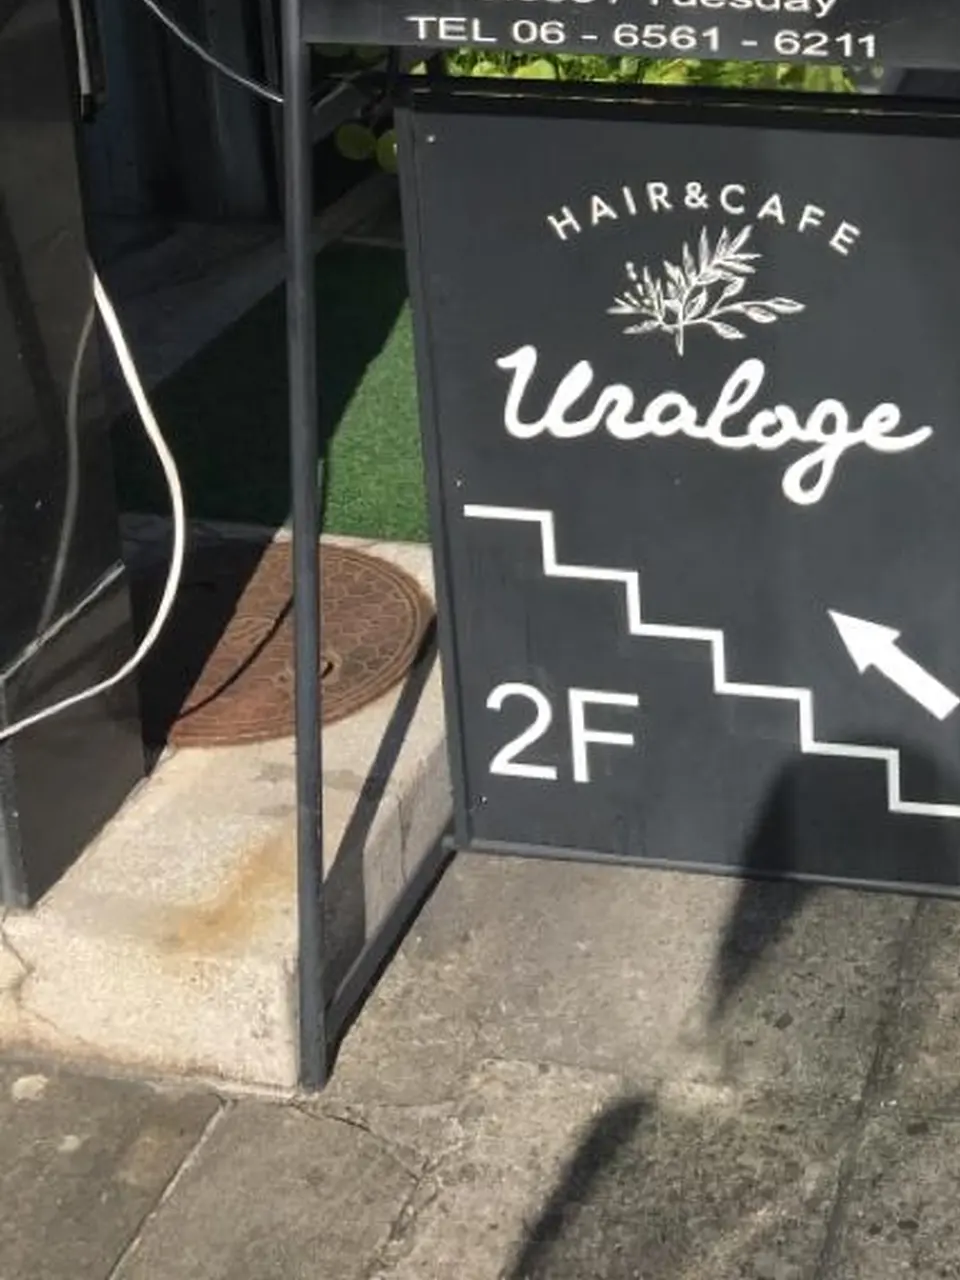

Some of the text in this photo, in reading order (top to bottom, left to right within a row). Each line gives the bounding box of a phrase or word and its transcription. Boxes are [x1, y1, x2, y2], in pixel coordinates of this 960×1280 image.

[406, 15, 498, 43] TEL
[511, 19, 566, 45] 06
[612, 23, 720, 53] 6561
[773, 29, 875, 59] 6211
[547, 181, 860, 255] HAIR&CAFE
[496, 344, 934, 506] Uraloge
[486, 682, 640, 783] 2F
